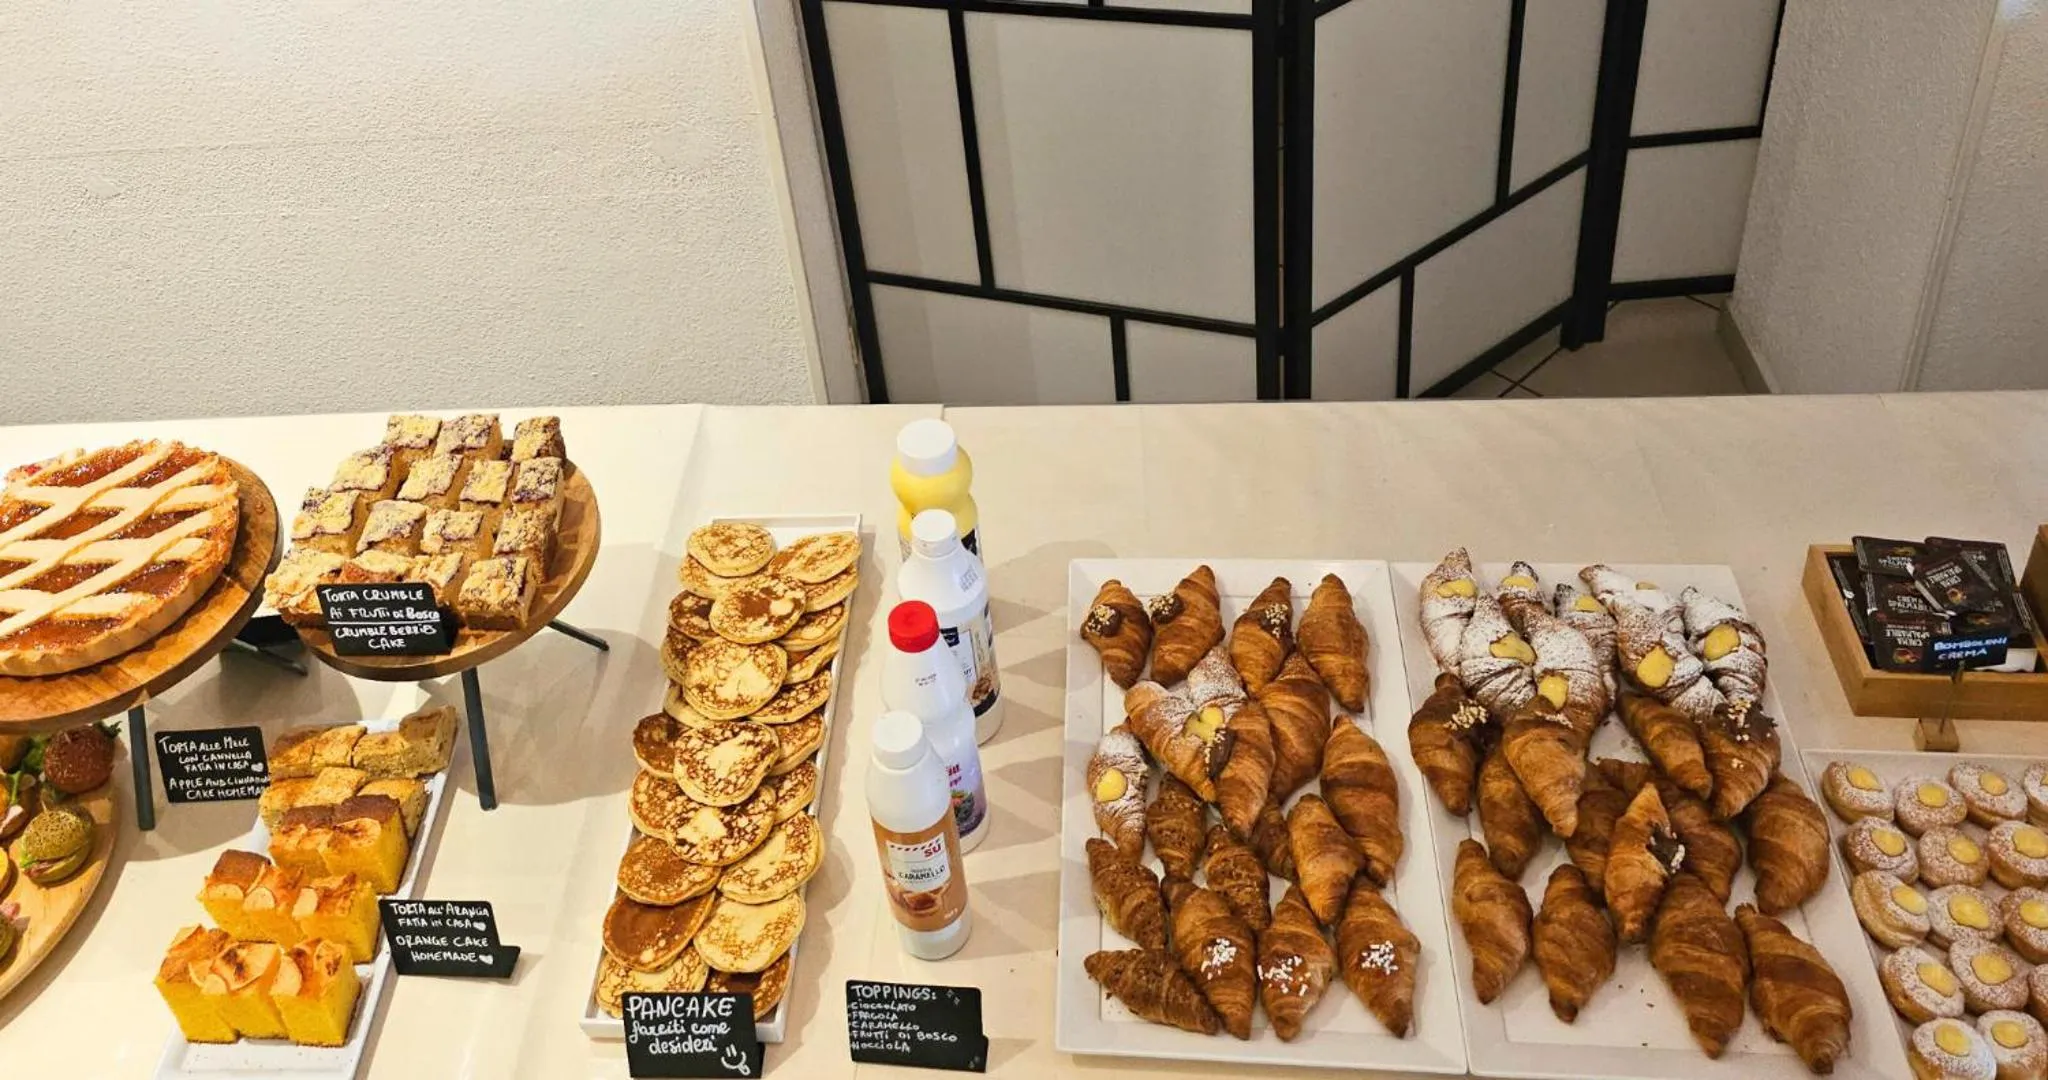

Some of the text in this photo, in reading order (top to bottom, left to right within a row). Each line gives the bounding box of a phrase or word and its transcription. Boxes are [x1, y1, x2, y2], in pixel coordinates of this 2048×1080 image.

[322, 588, 424, 602] TORTA CRUMBLE
[335, 626, 387, 638] CRUMBLE
[368, 638, 407, 650] CAKE
[1938, 647, 1987, 660] CREMA
[159, 736, 197, 754] TORTA
[203, 751, 252, 762] CANNELLA
[228, 760, 249, 769] CASA
[169, 777, 203, 790] APPLE
[205, 778, 226, 787] AND
[187, 789, 215, 800] CAKE
[899, 865, 946, 880] CARAMELLO
[390, 902, 425, 915] TORTA
[446, 918, 472, 928] CASA
[395, 934, 489, 947] ORANGE CAKE
[411, 950, 478, 963] HOMEMADE
[851, 984, 937, 1001] TOPPINGS:
[626, 995, 737, 1020] PANCAKE
[691, 1022, 731, 1034] come
[917, 1031, 958, 1043] BOSCO
[649, 1034, 718, 1054] desideri
